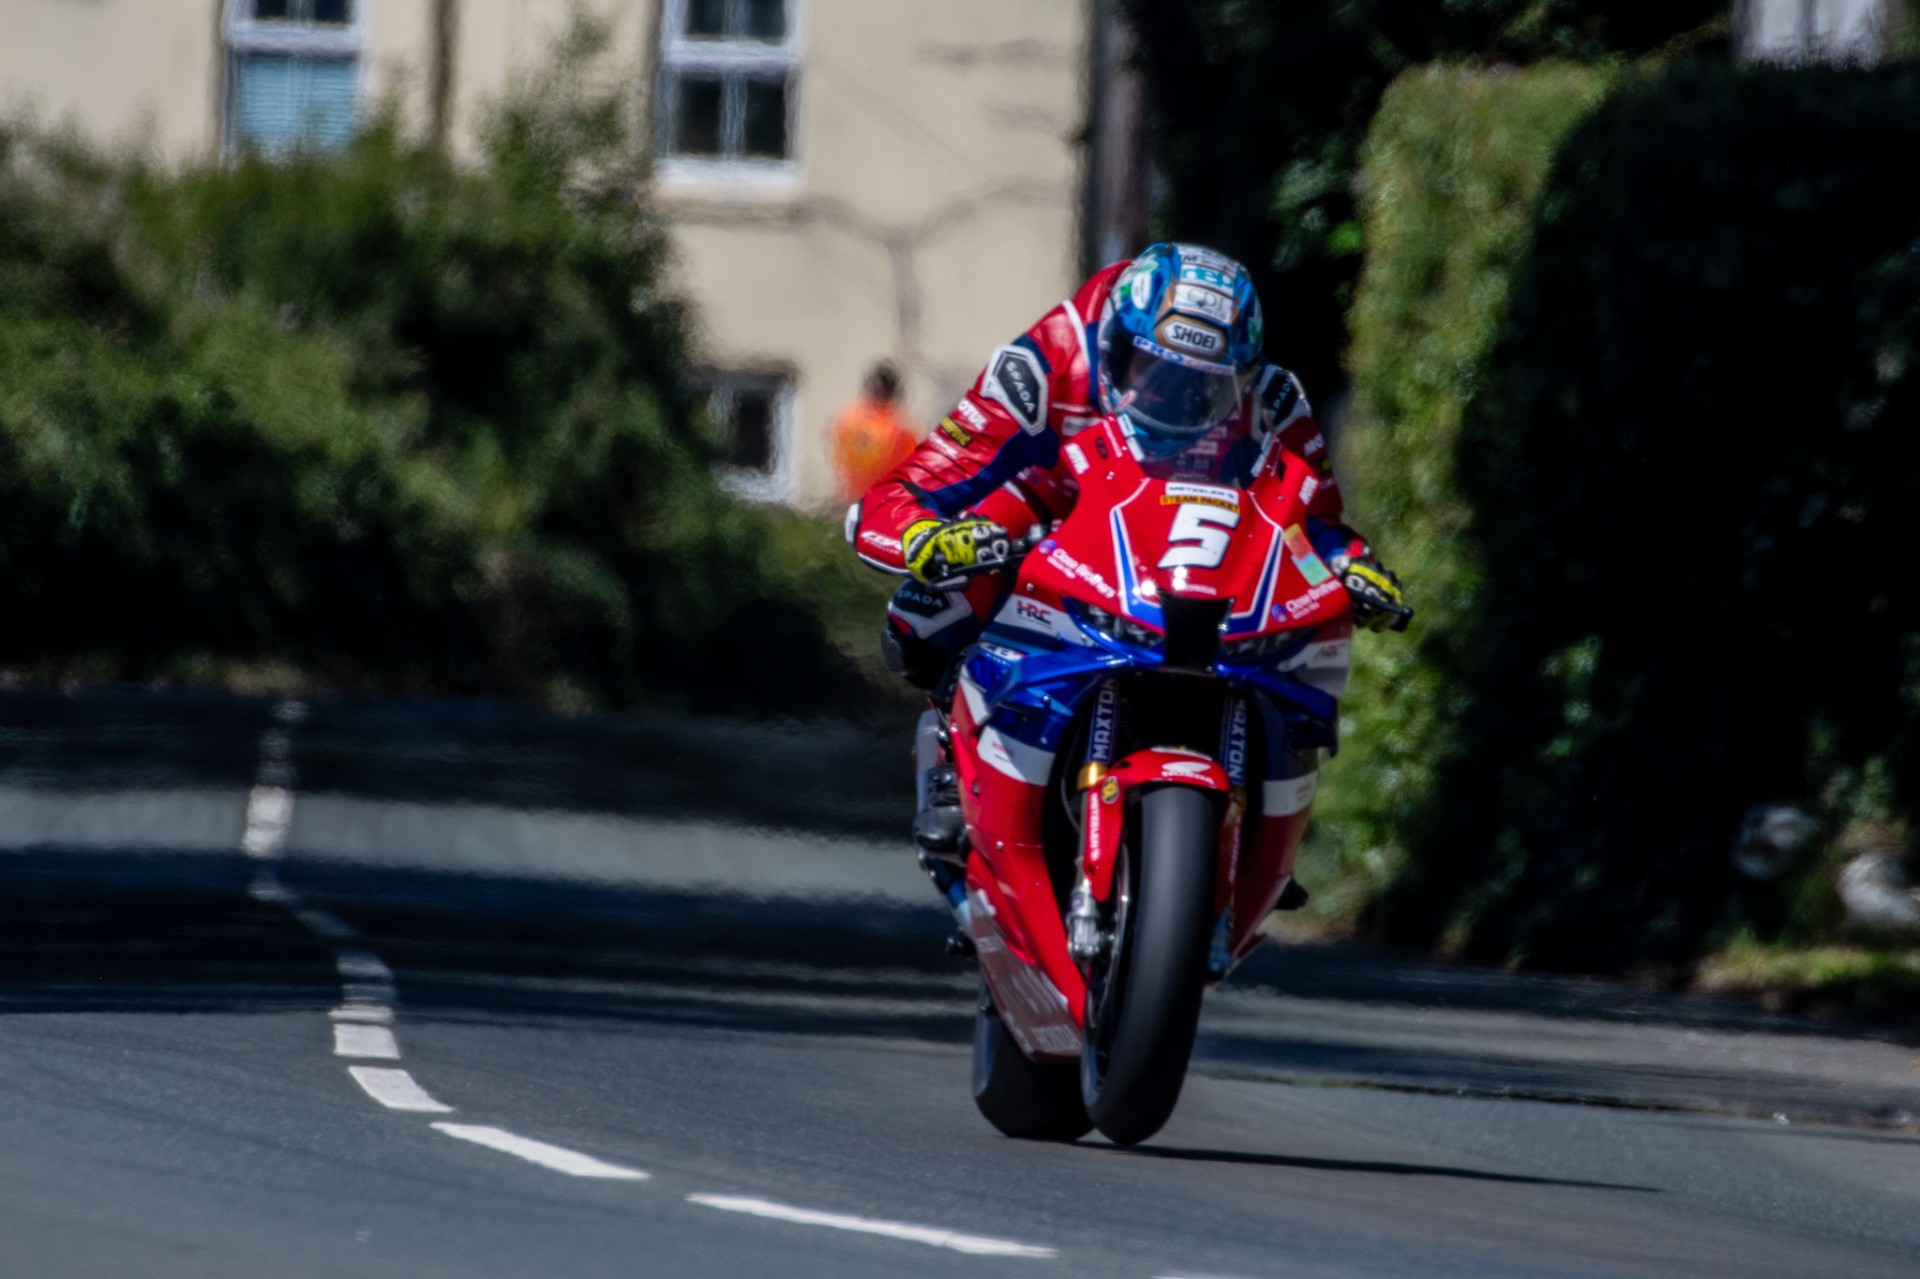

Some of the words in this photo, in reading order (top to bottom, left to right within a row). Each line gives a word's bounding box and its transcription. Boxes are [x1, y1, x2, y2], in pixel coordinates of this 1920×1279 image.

[1172, 324, 1217, 349] SHOEI
[1005, 361, 1035, 414] SPADA
[958, 399, 987, 431] OTUL
[1157, 502, 1240, 569] 5
[1053, 548, 1078, 569] Close
[1075, 564, 1116, 599] Brothers
[1016, 599, 1052, 624] HRC
[1286, 594, 1311, 612] Close
